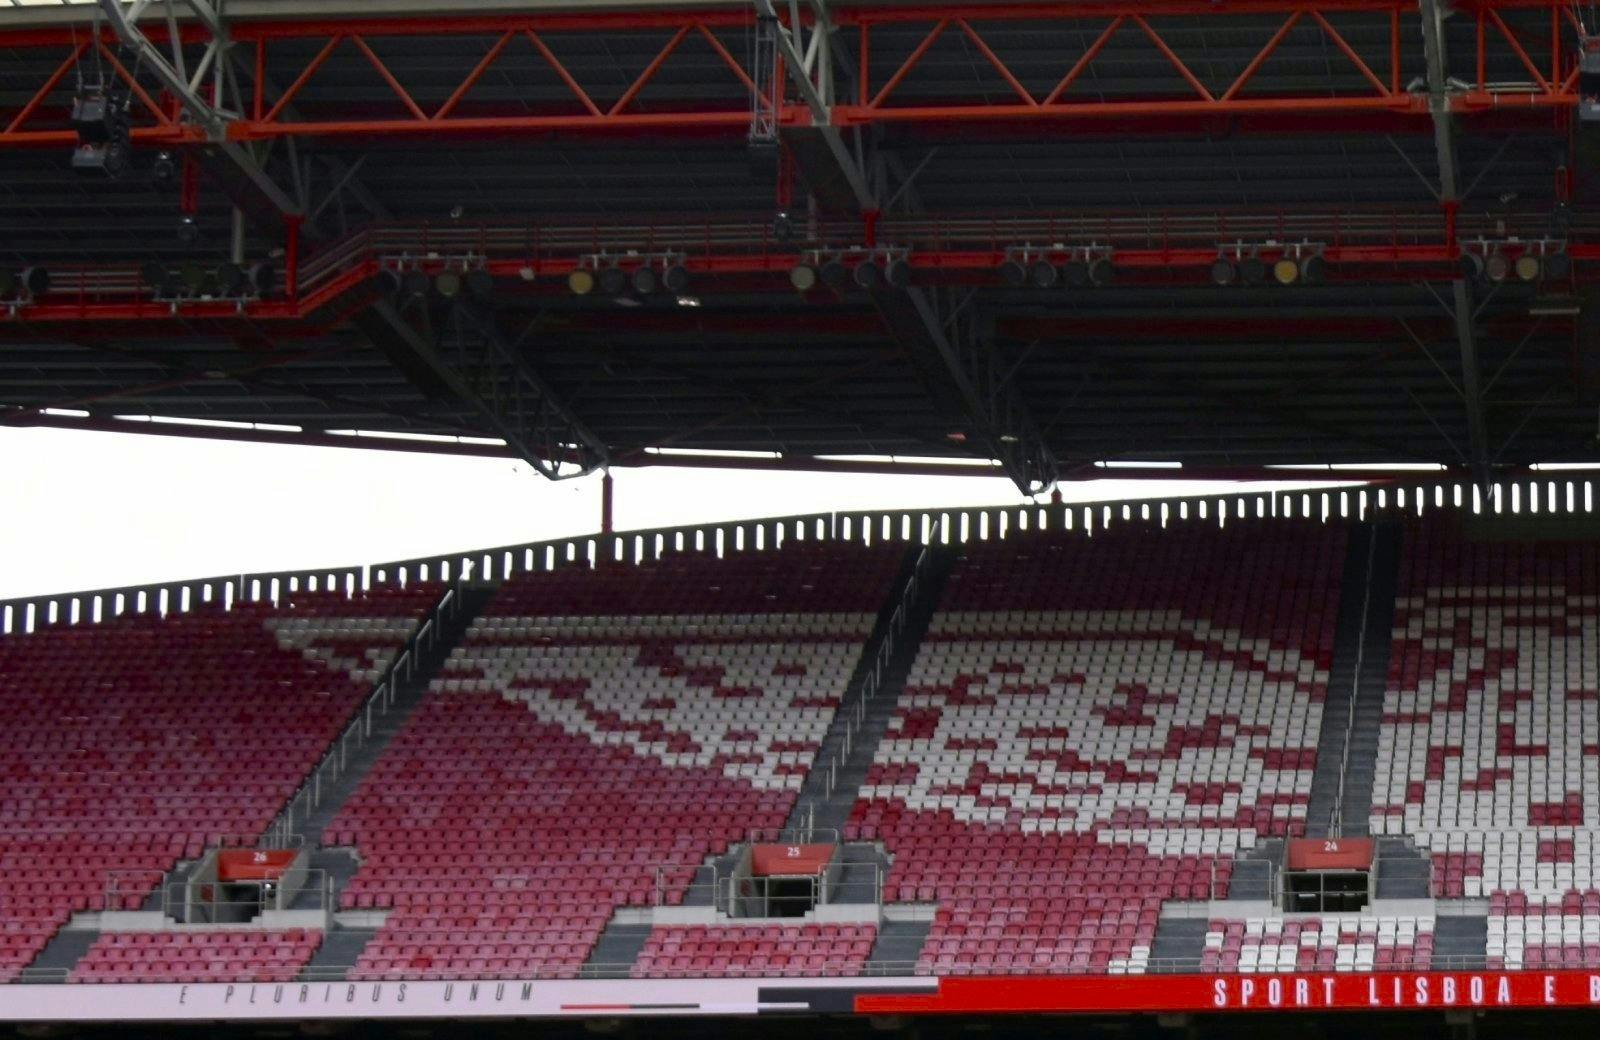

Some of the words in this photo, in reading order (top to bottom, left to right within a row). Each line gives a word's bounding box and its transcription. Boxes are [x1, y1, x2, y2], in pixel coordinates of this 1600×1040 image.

[787, 846, 801, 858] 25
[1324, 840, 1339, 852] 24
[253, 851, 268, 862] 26
[178, 985, 188, 1004] E
[225, 983, 408, 1004] PLURIBUS
[443, 982, 533, 1002] UNUM
[1213, 977, 1336, 1007] SPORT
[1368, 975, 1512, 1006] LISBOA
[1543, 974, 1556, 1004] E
